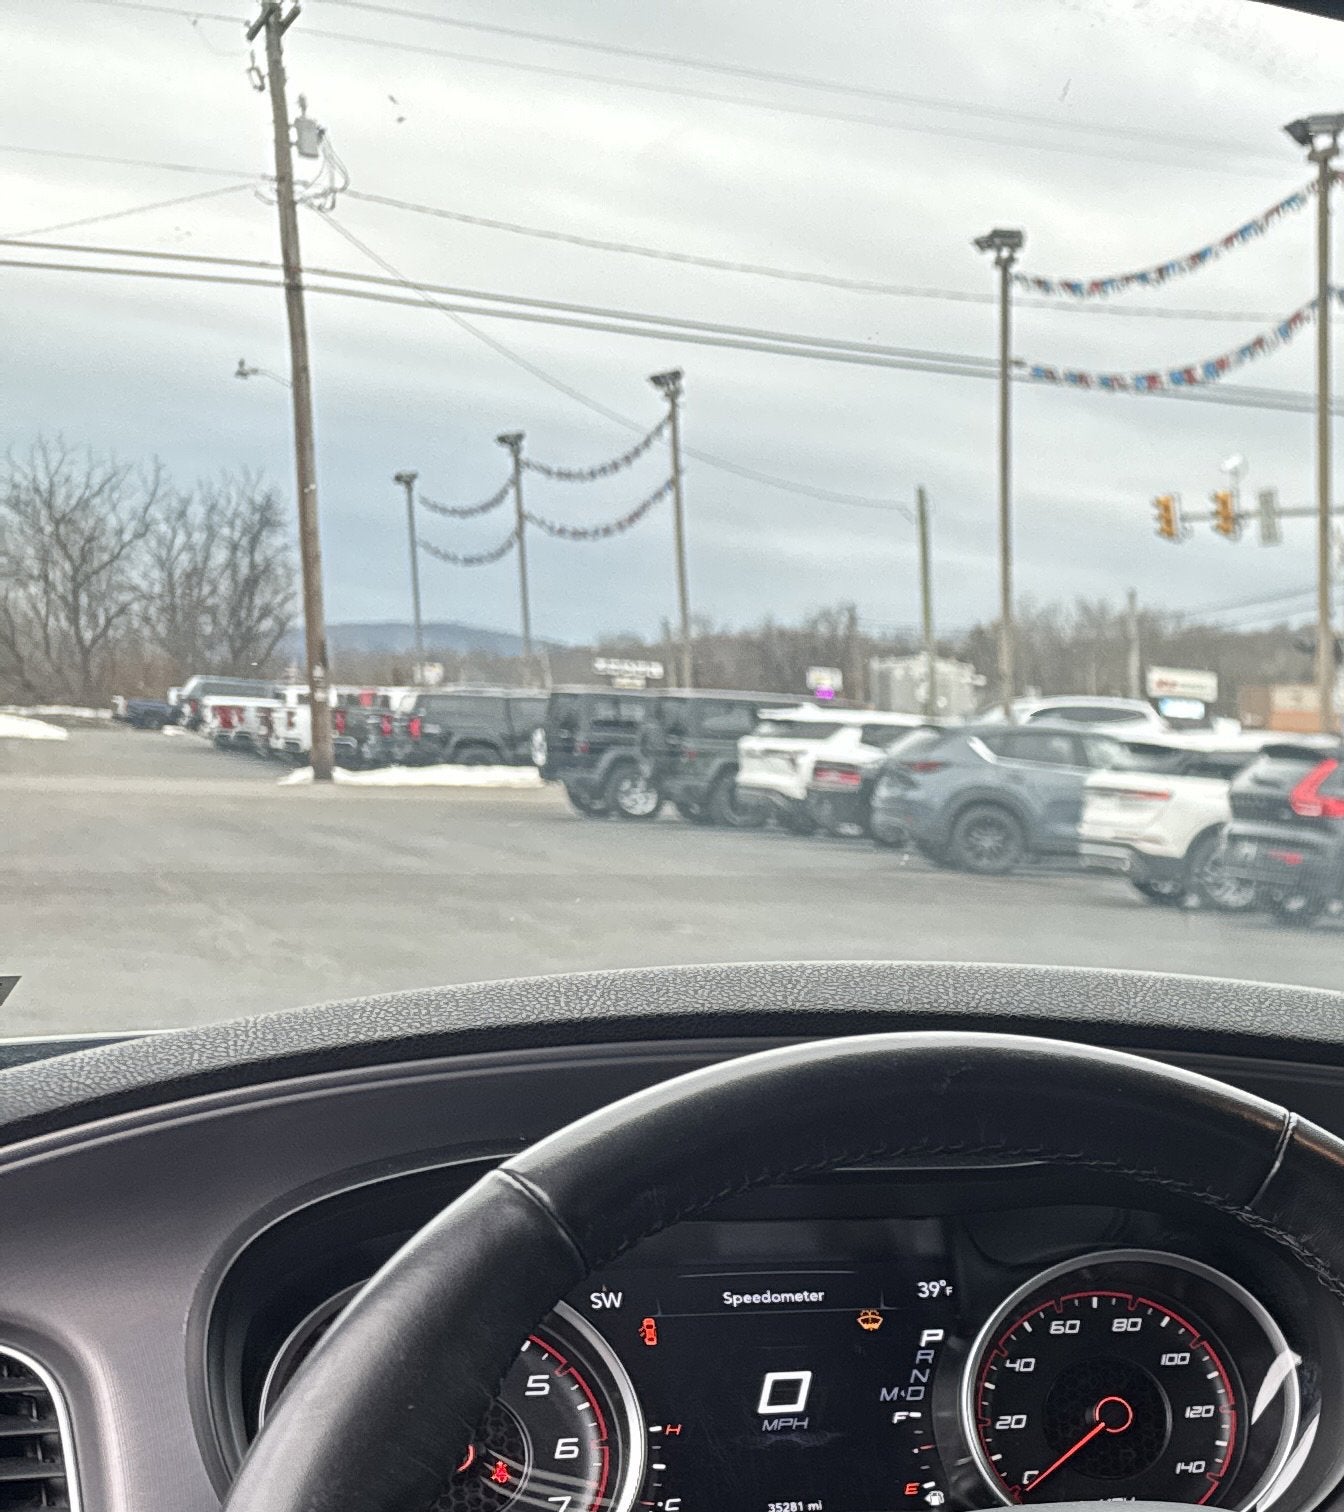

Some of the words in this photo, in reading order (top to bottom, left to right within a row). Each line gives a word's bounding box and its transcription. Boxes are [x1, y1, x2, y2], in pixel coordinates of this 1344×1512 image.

[589, 1291, 623, 1309] SW
[722, 1290, 825, 1307] Speedometer
[1050, 1320, 1081, 1334] 60
[1112, 1318, 1142, 1332] 80
[920, 1329, 944, 1347] P
[916, 1350, 934, 1364] R
[1160, 1353, 1190, 1365] 100
[1005, 1358, 1036, 1372] 40
[910, 1369, 930, 1384] N
[525, 1374, 551, 1397] 5
[757, 1370, 812, 1415] 0
[880, 1387, 899, 1402] M
[906, 1386, 925, 1401] D
[892, 1411, 909, 1424] F
[1185, 1405, 1215, 1418] 120
[762, 1417, 809, 1432] MPH
[996, 1415, 1027, 1429] 20
[666, 1424, 682, 1435] H
[554, 1438, 579, 1459] 6
[1176, 1461, 1206, 1474] 140
[904, 1483, 920, 1495] E
[664, 1498, 682, 1511] C
[807, 1501, 823, 1512] mi
